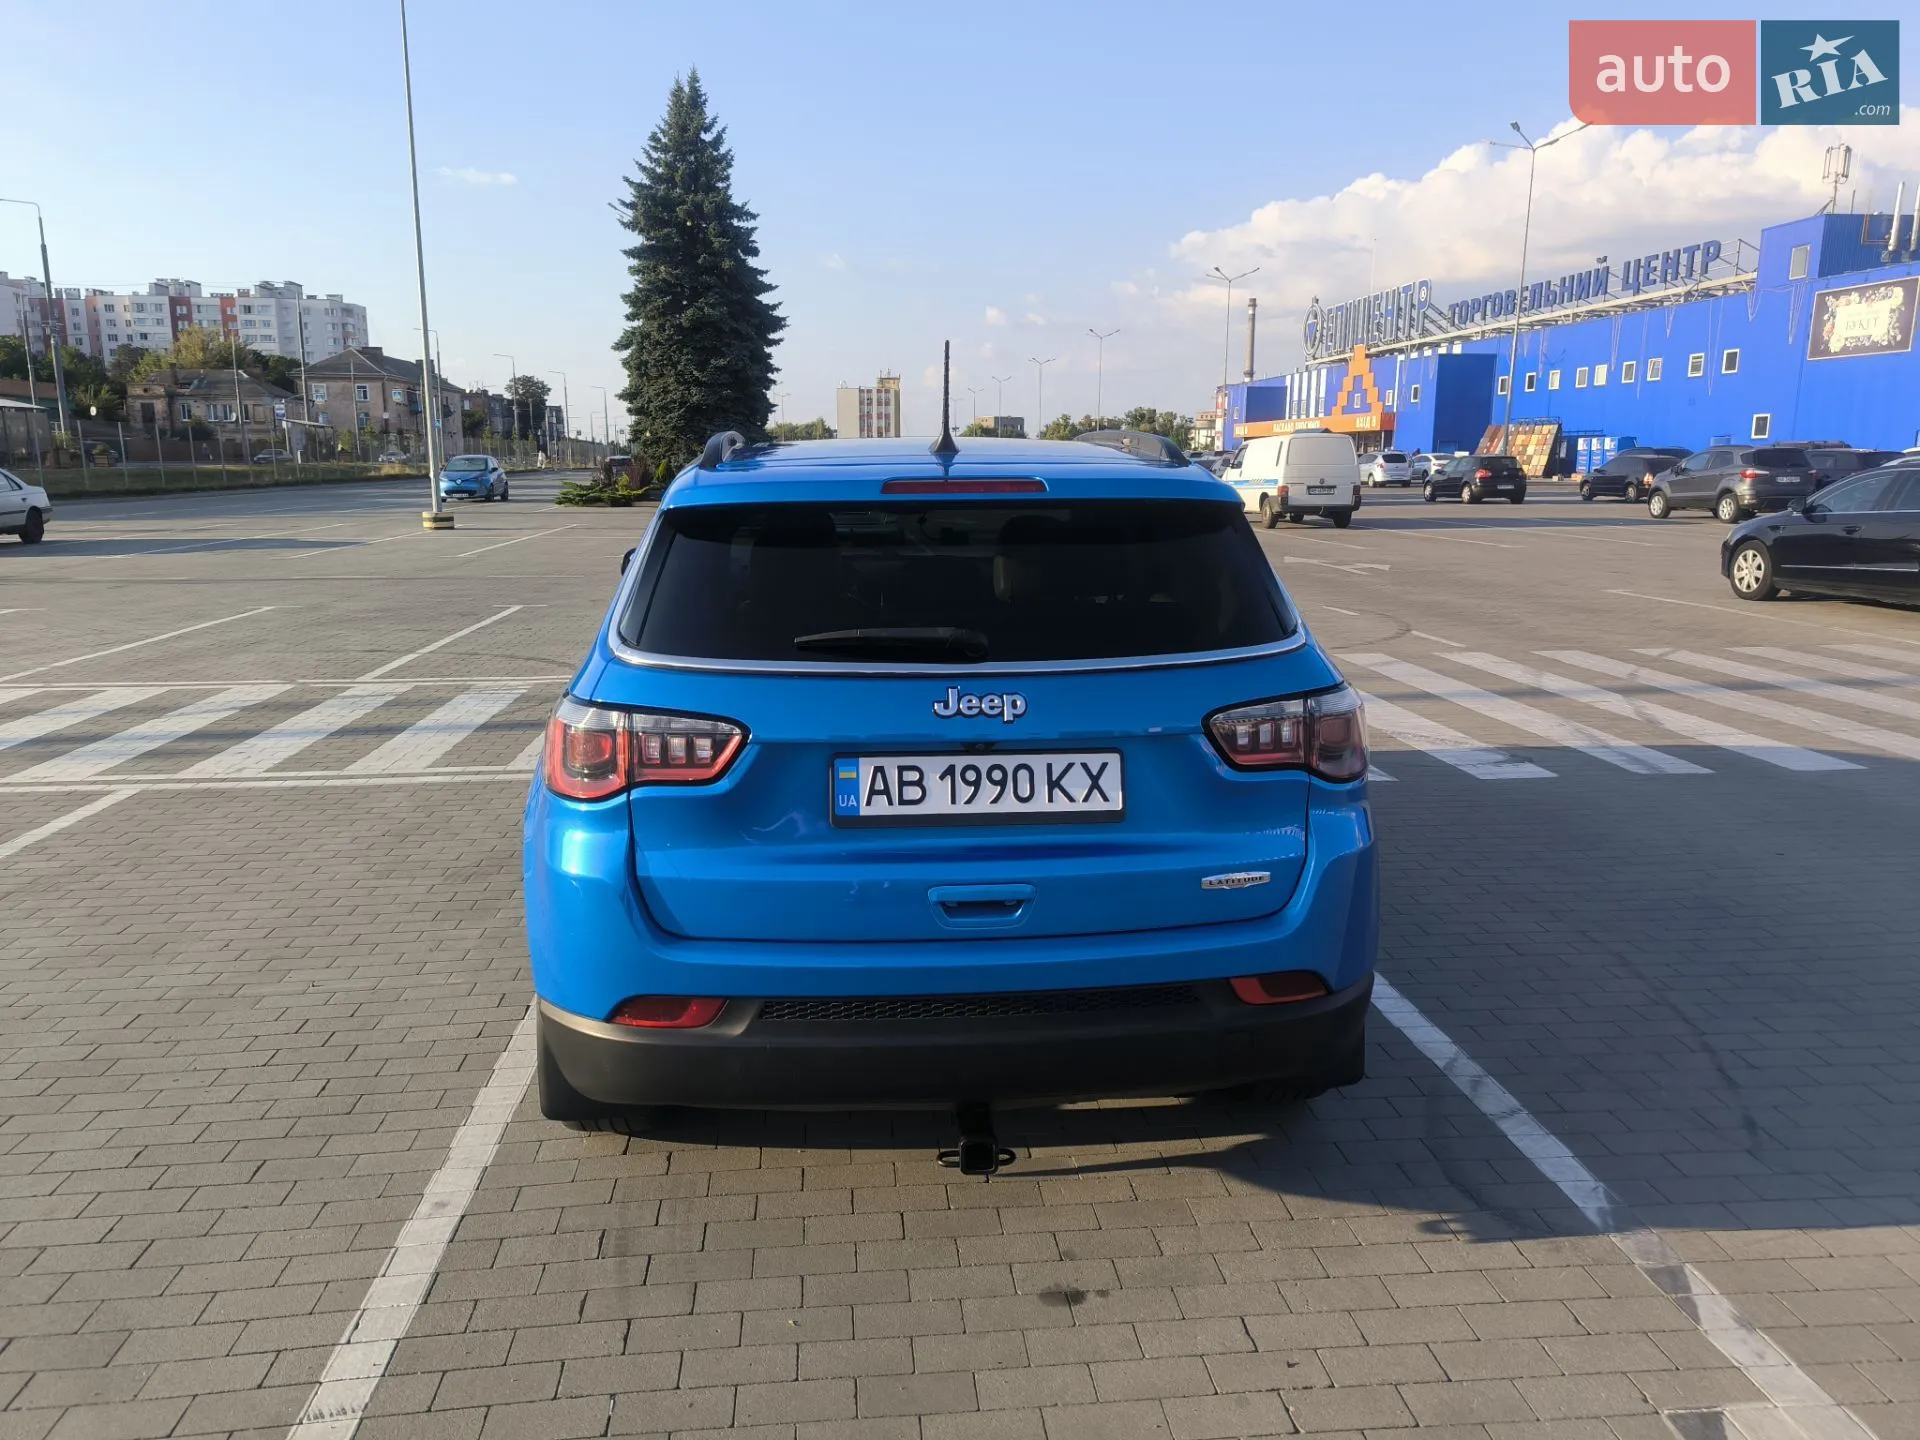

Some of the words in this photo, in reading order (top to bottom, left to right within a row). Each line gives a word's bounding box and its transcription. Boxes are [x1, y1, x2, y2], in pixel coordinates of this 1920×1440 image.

[1324, 278, 1431, 354] ЕПІЦЕНТР
[1447, 255, 1610, 327] ТОРГОВЕЛЬНИЙ
[1621, 239, 1722, 297] ЦЕНТР
[932, 686, 1028, 723] Jeep
[838, 794, 857, 807] UA
[863, 765, 928, 806] AB
[937, 762, 1035, 805] 1990
[1046, 761, 1110, 804] KX
